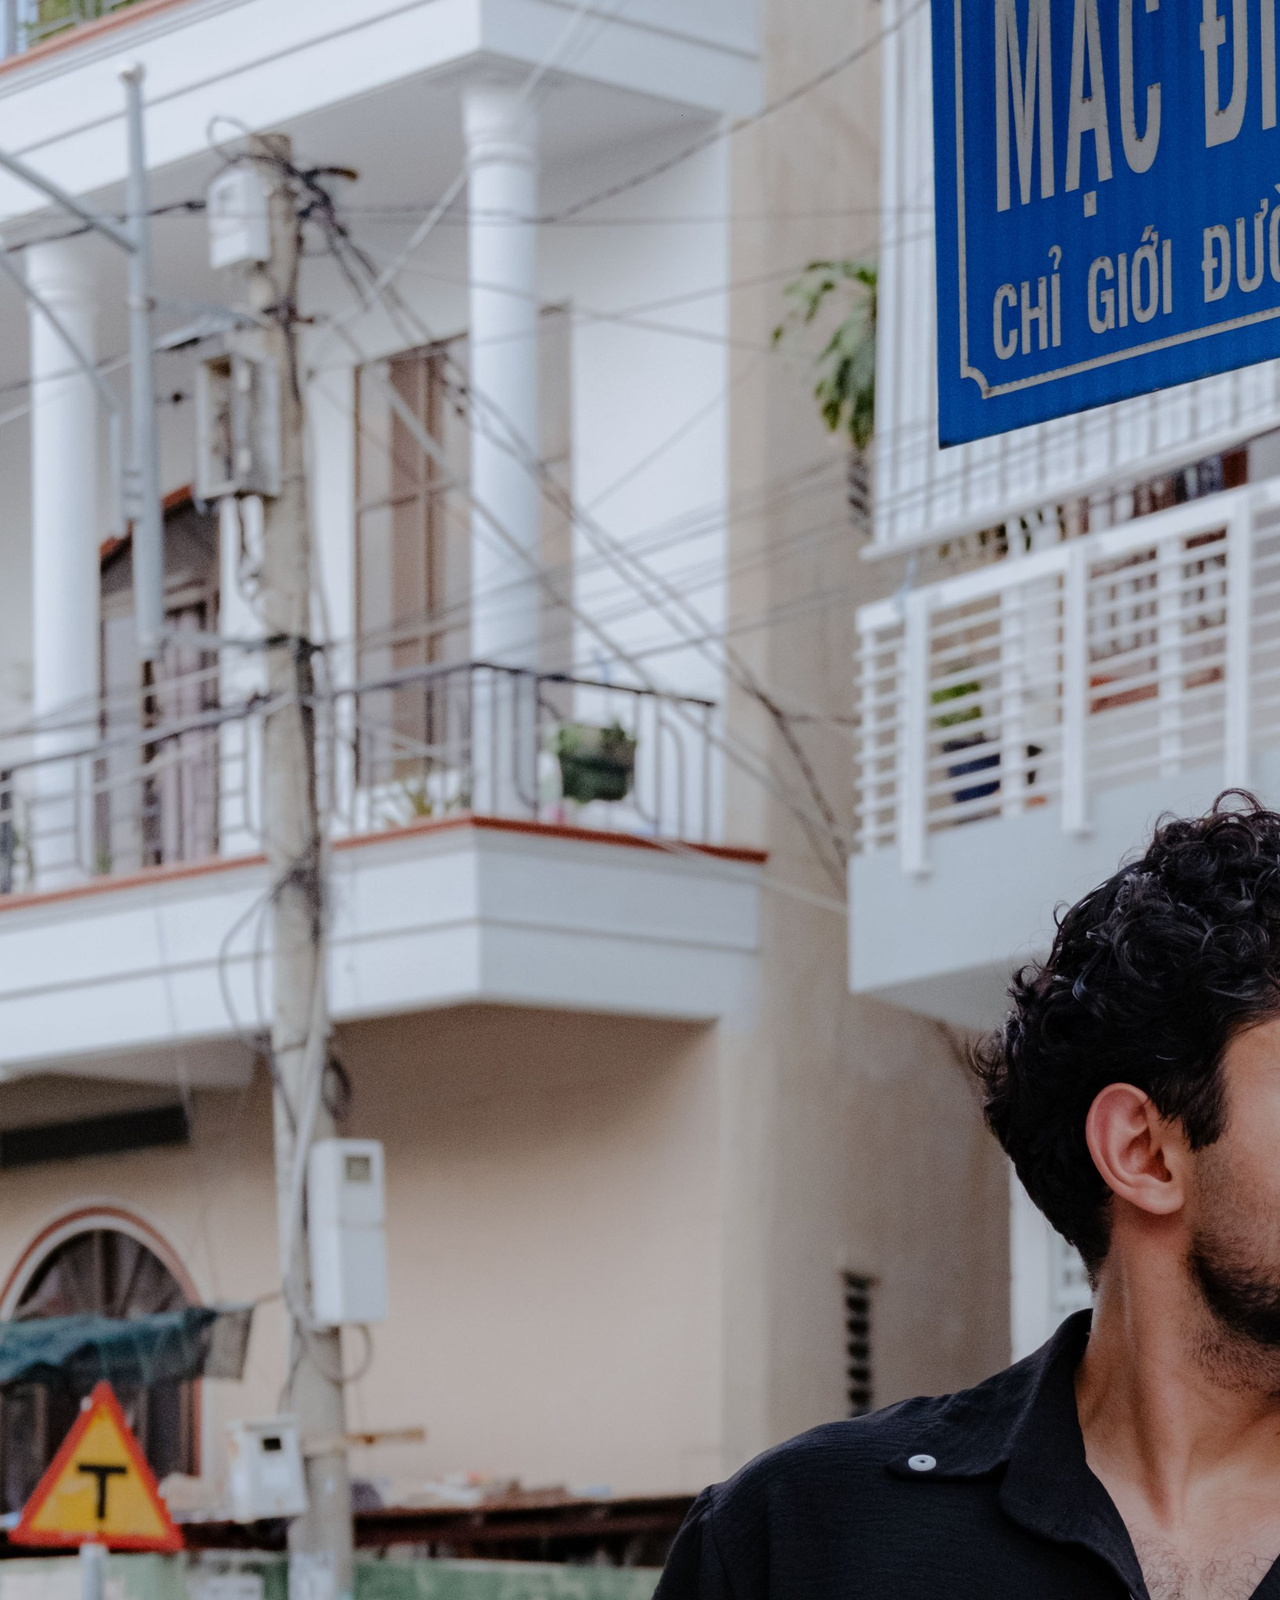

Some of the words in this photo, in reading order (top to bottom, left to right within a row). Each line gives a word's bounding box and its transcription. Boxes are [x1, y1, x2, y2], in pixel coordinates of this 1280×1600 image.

[995, 0, 1161, 218] MẠC
[992, 245, 1062, 360] CHỈ
[1087, 225, 1173, 334] GIỚI
